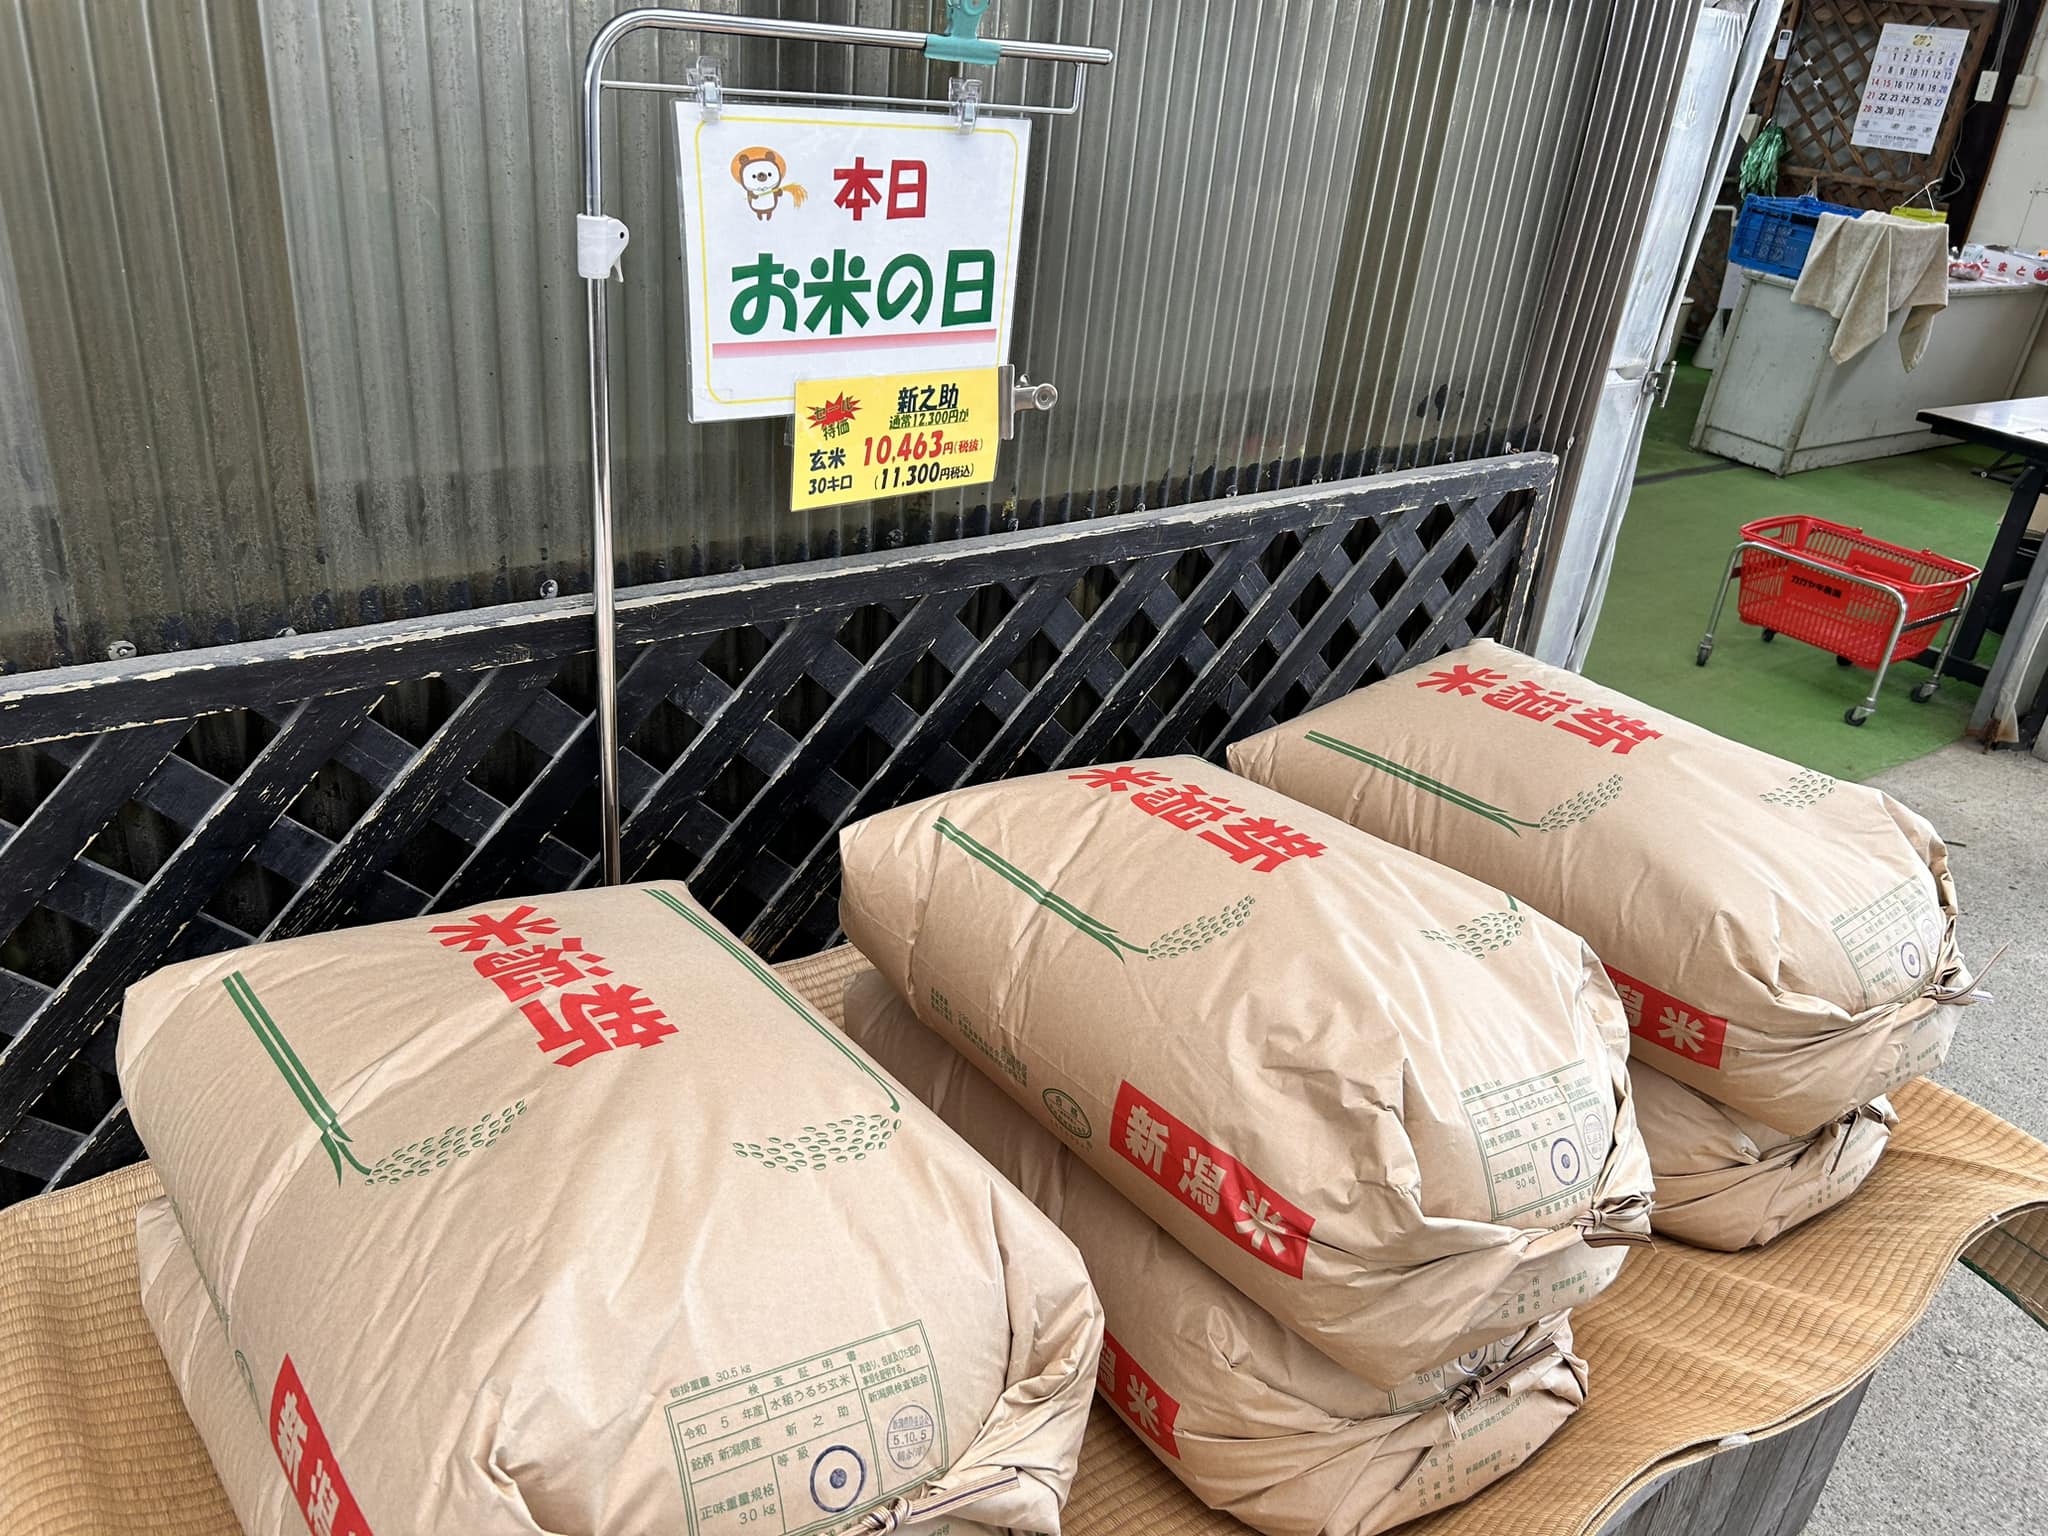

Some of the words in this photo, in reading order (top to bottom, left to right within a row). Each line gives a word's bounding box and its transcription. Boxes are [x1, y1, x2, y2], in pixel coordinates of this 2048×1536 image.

[1910, 68, 1917, 76] 10
[1928, 84, 1936, 92] 19
[1886, 107, 1894, 115] 30
[833, 156, 927, 221] 本日
[729, 248, 995, 335] お米の日
[814, 397, 852, 421] セール
[897, 383, 959, 413] 新之助
[822, 419, 850, 440] 特価
[810, 447, 846, 471] 玄米
[808, 475, 852, 495] 30キロ
[1791, 575, 1842, 598] カガヤキ
[1416, 664, 1664, 754] 新潟米
[1068, 766, 1328, 872] 新潟米
[427, 905, 680, 1067] 新潟米
[1125, 1104, 1287, 1256] 新潟米
[1515, 1178, 1526, 1189] 30
[716, 1367, 738, 1383] 30.5
[740, 1364, 752, 1375] kg
[1417, 1373, 1430, 1385] 30
[1433, 1369, 1442, 1379] kg
[769, 1375, 851, 1411] 水稲うるち玄米
[684, 1423, 707, 1440] 令和
[720, 1416, 729, 1429] 5
[742, 1404, 764, 1420] 年産
[276, 1389, 358, 1536] 新潟
[690, 1452, 715, 1473] 銘柄
[718, 1436, 763, 1461] 新潟県産
[700, 1483, 775, 1521] 正味重量規格
[739, 1508, 758, 1525] 30
[763, 1503, 776, 1516] kg
